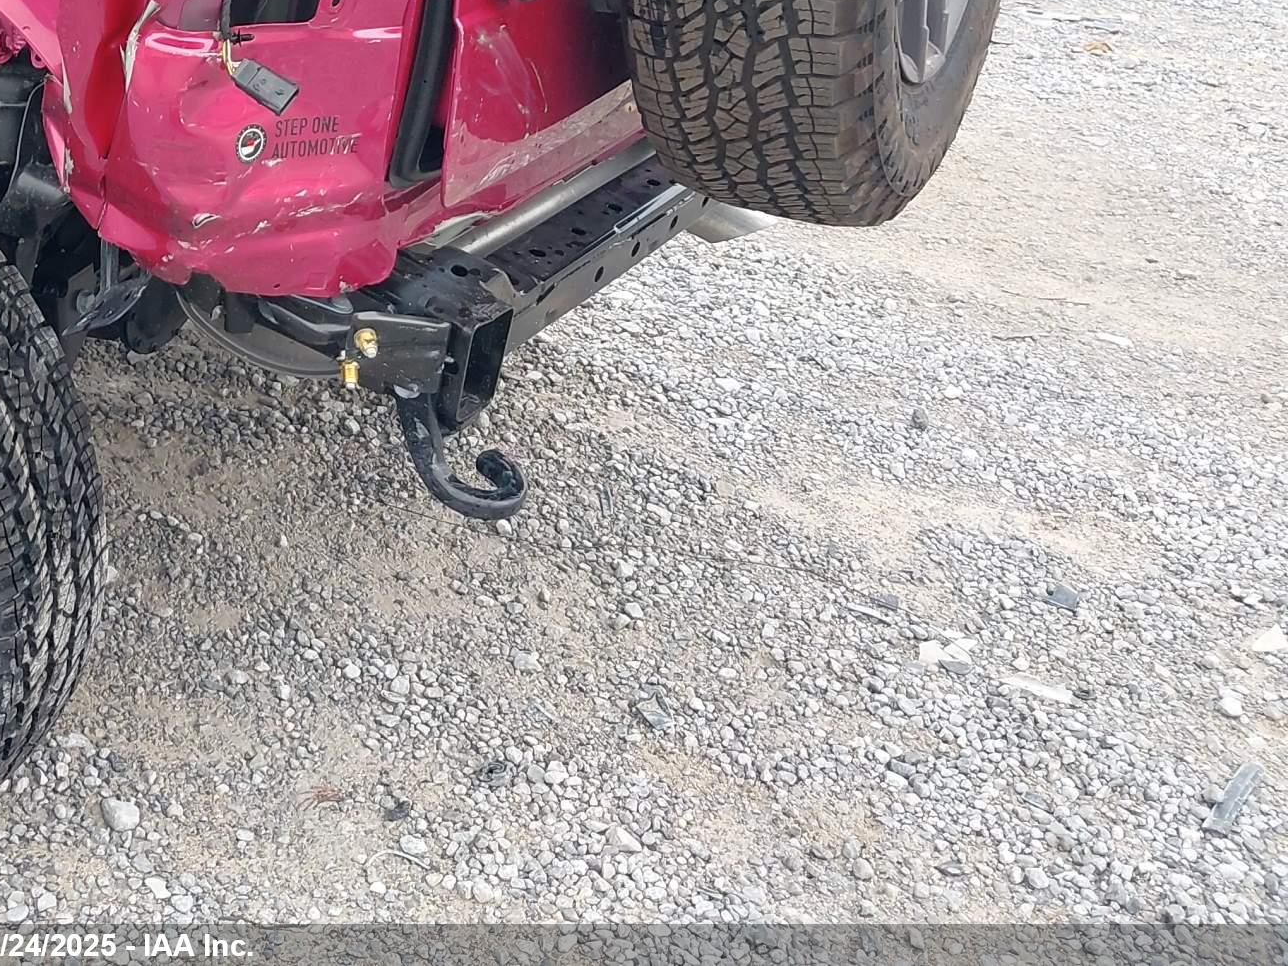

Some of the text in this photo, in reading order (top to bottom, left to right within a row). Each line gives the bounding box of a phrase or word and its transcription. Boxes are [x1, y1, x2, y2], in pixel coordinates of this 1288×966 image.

[275, 116, 339, 138] STEP ONE
[272, 136, 359, 159] AUTOMOTIVE
